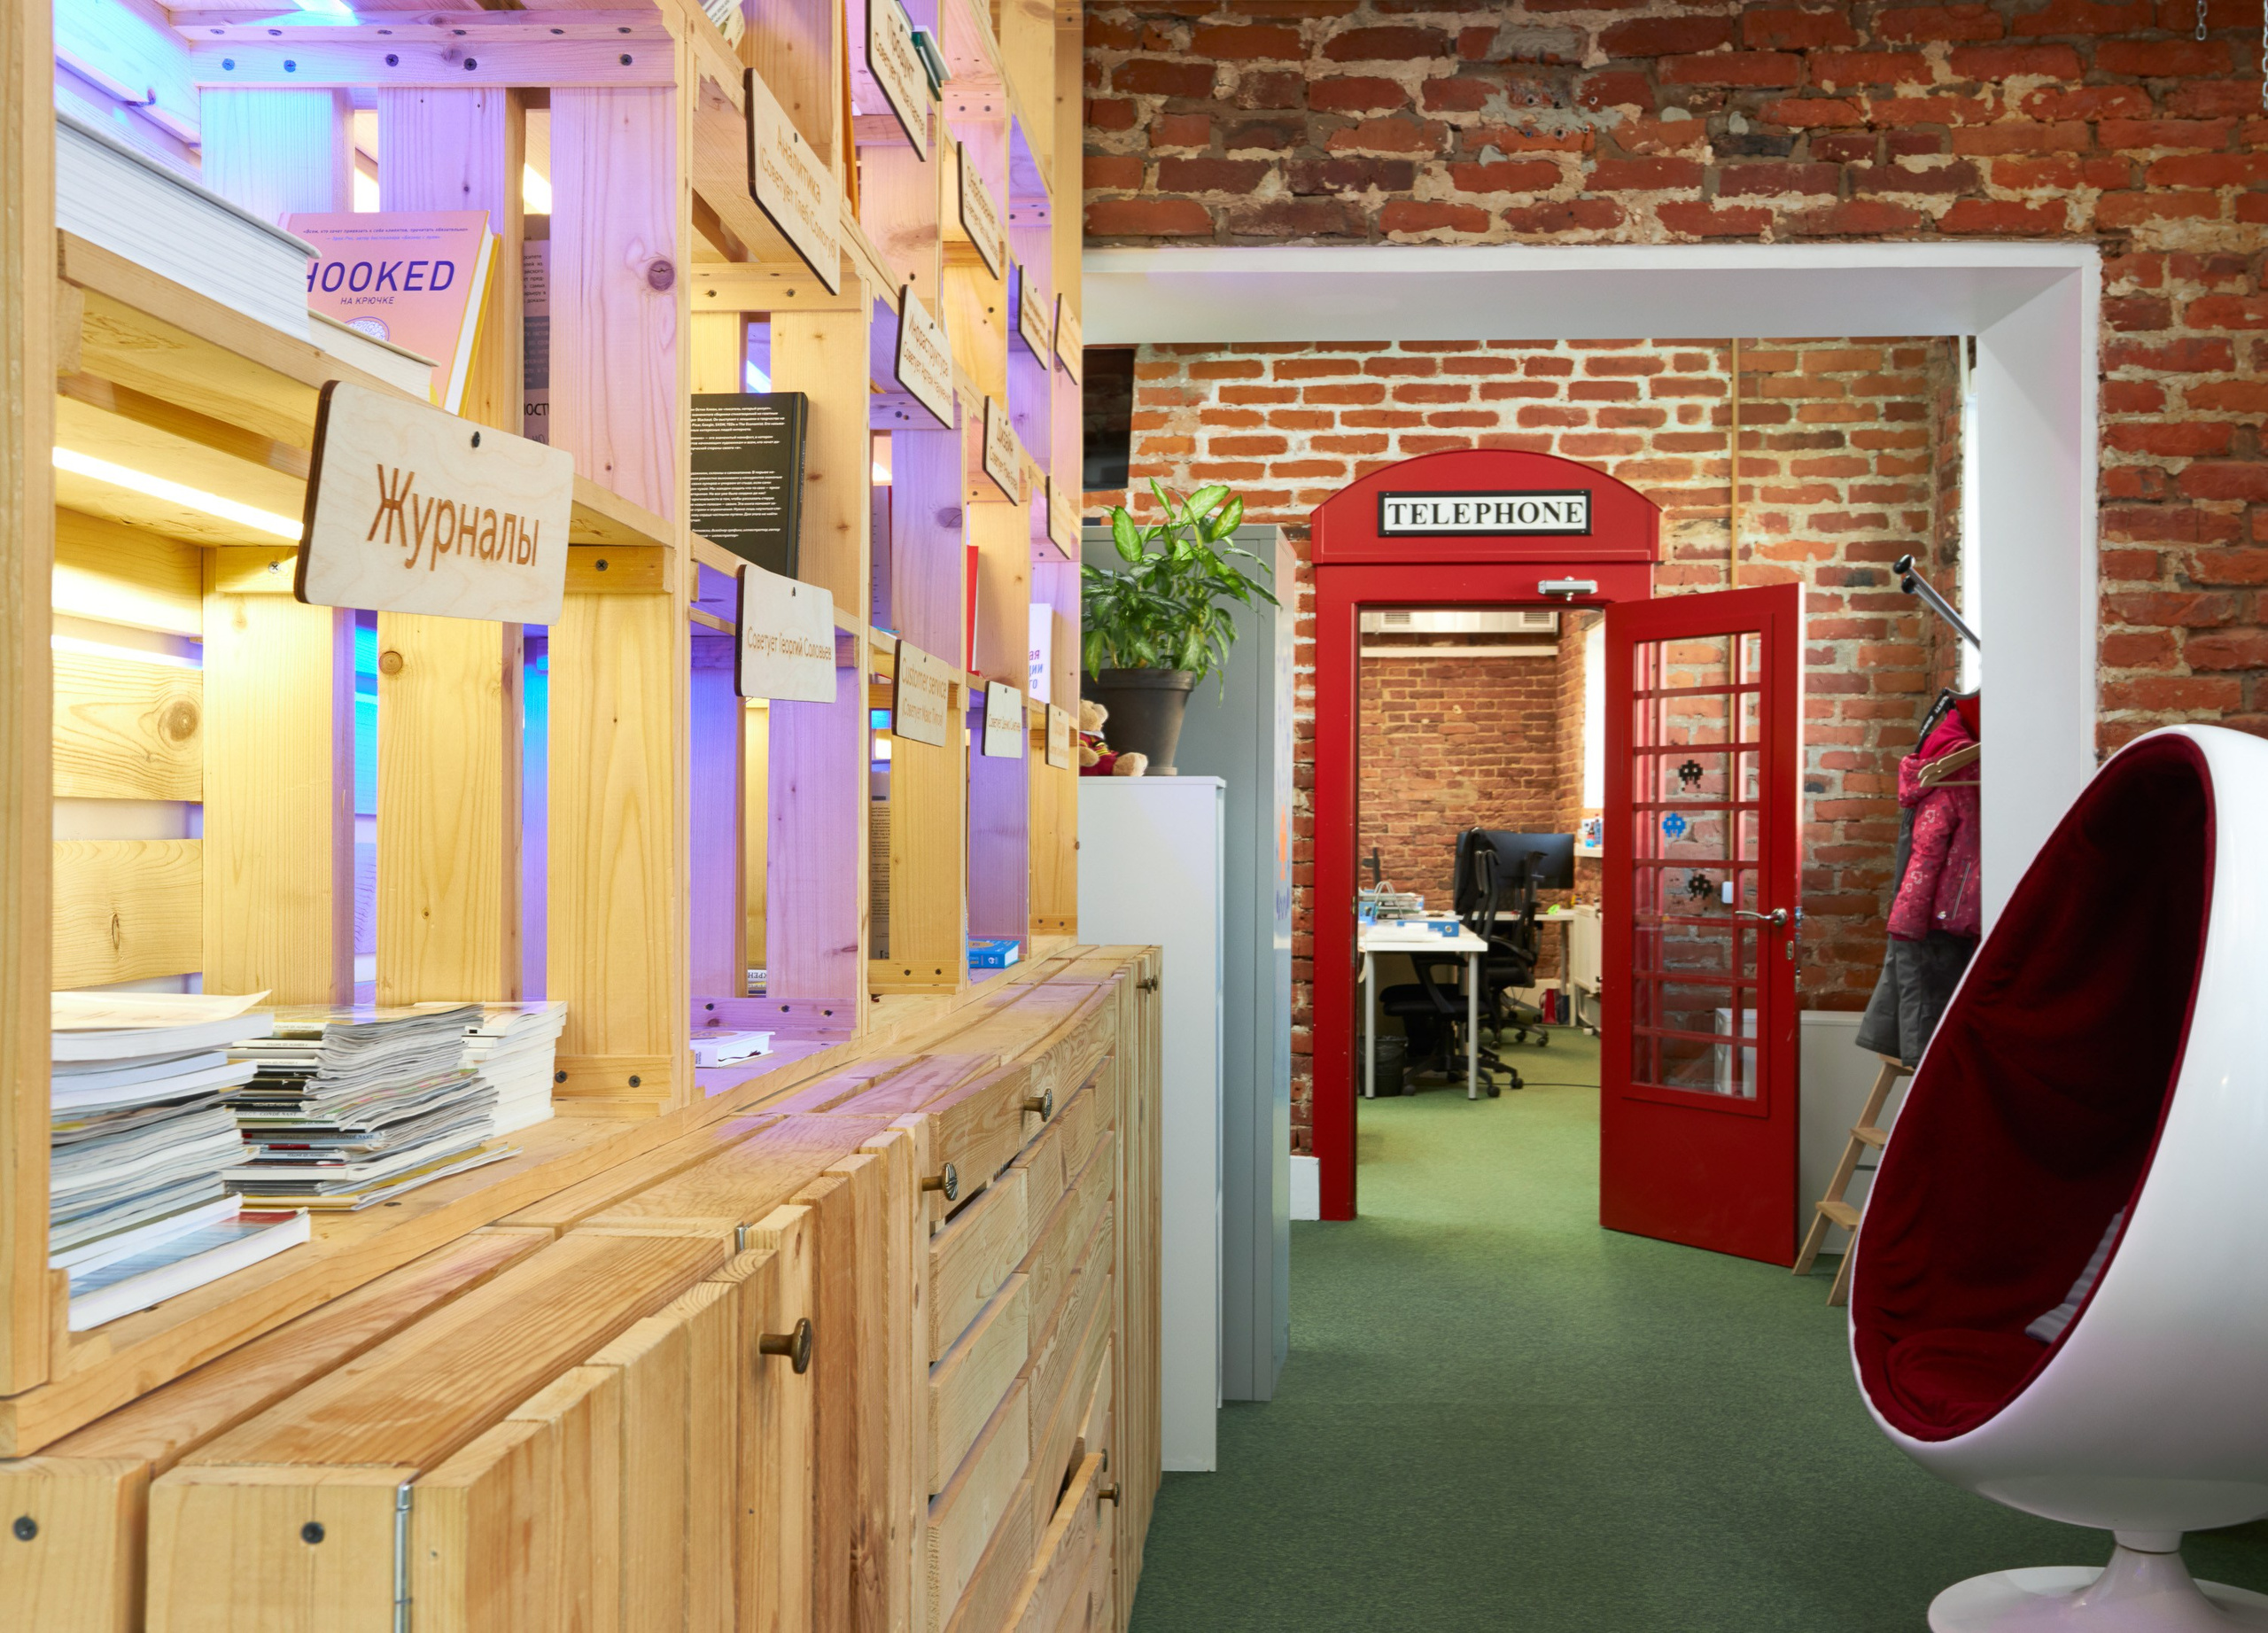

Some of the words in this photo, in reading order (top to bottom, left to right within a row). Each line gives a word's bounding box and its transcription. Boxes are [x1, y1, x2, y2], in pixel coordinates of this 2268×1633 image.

[777, 123, 821, 206] Аналитика
[354, 296, 395, 305] КРЮЧКЕ
[367, 463, 539, 572] Журналы
[1387, 502, 1584, 525] TELEPHONE
[747, 626, 778, 657] Советует
[779, 632, 803, 659] Георгий
[804, 637, 832, 660] Соловьев
[901, 657, 929, 691] Customer
[929, 675, 947, 700] service
